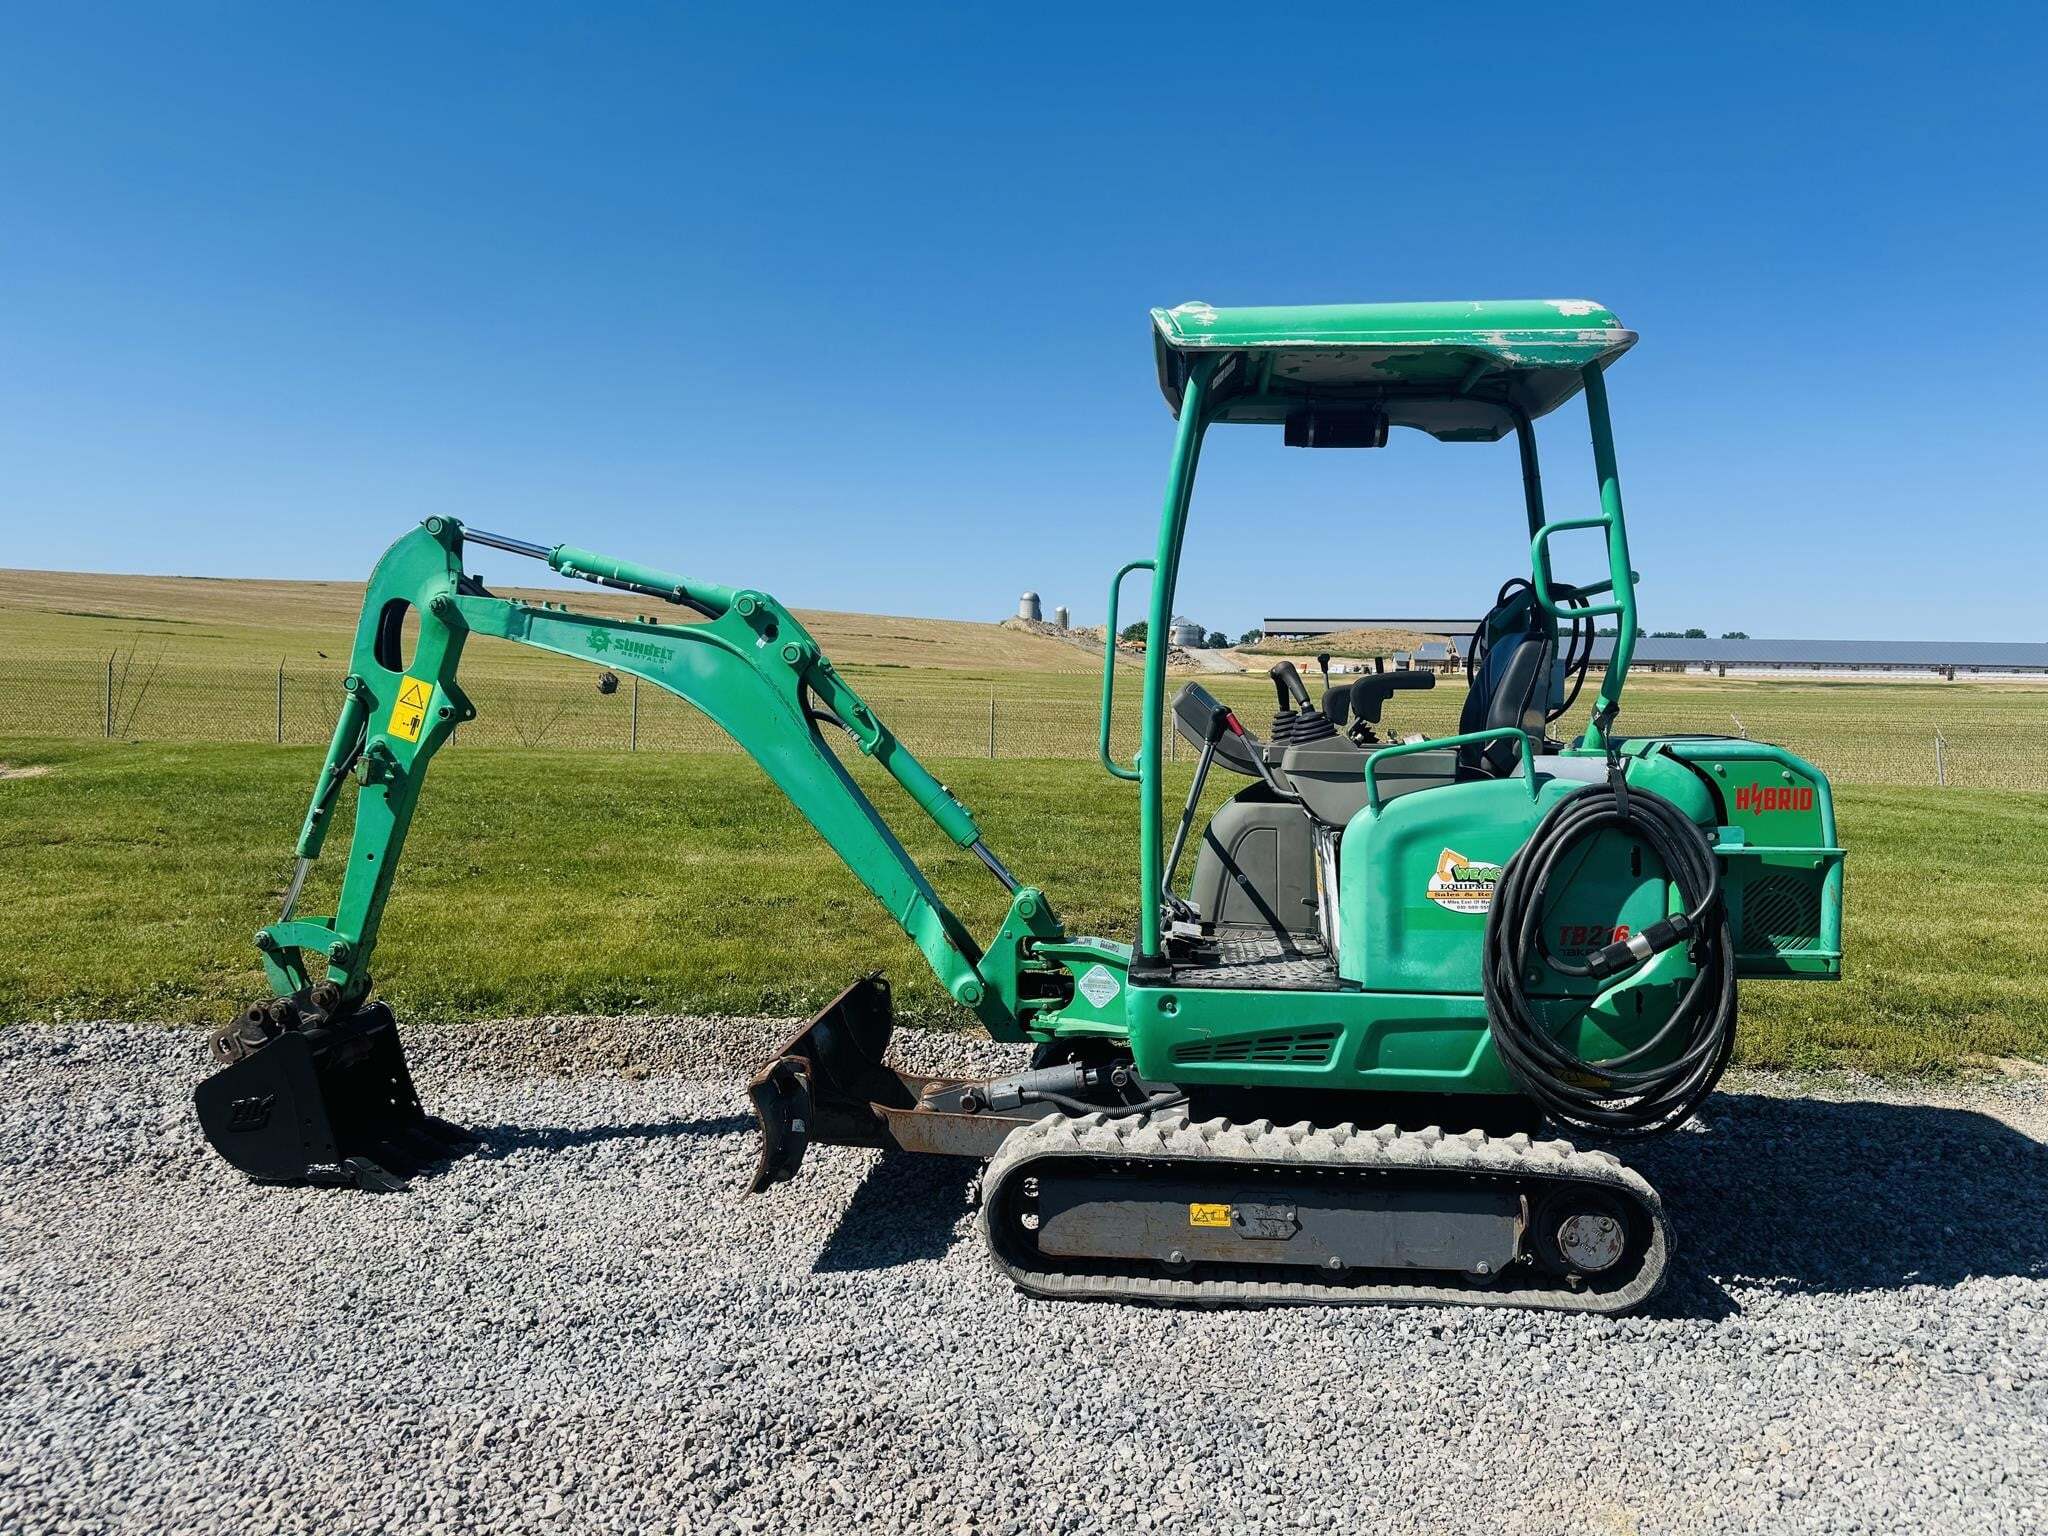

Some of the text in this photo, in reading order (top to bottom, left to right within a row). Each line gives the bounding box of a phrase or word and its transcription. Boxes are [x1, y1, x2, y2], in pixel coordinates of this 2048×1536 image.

[614, 638, 675, 661] SUNBELT
[621, 650, 666, 664] RENTALS
[1736, 783, 1813, 815] HYBRID
[1440, 883, 1493, 891] EQUIPME
[1560, 925, 1630, 945] TB216
